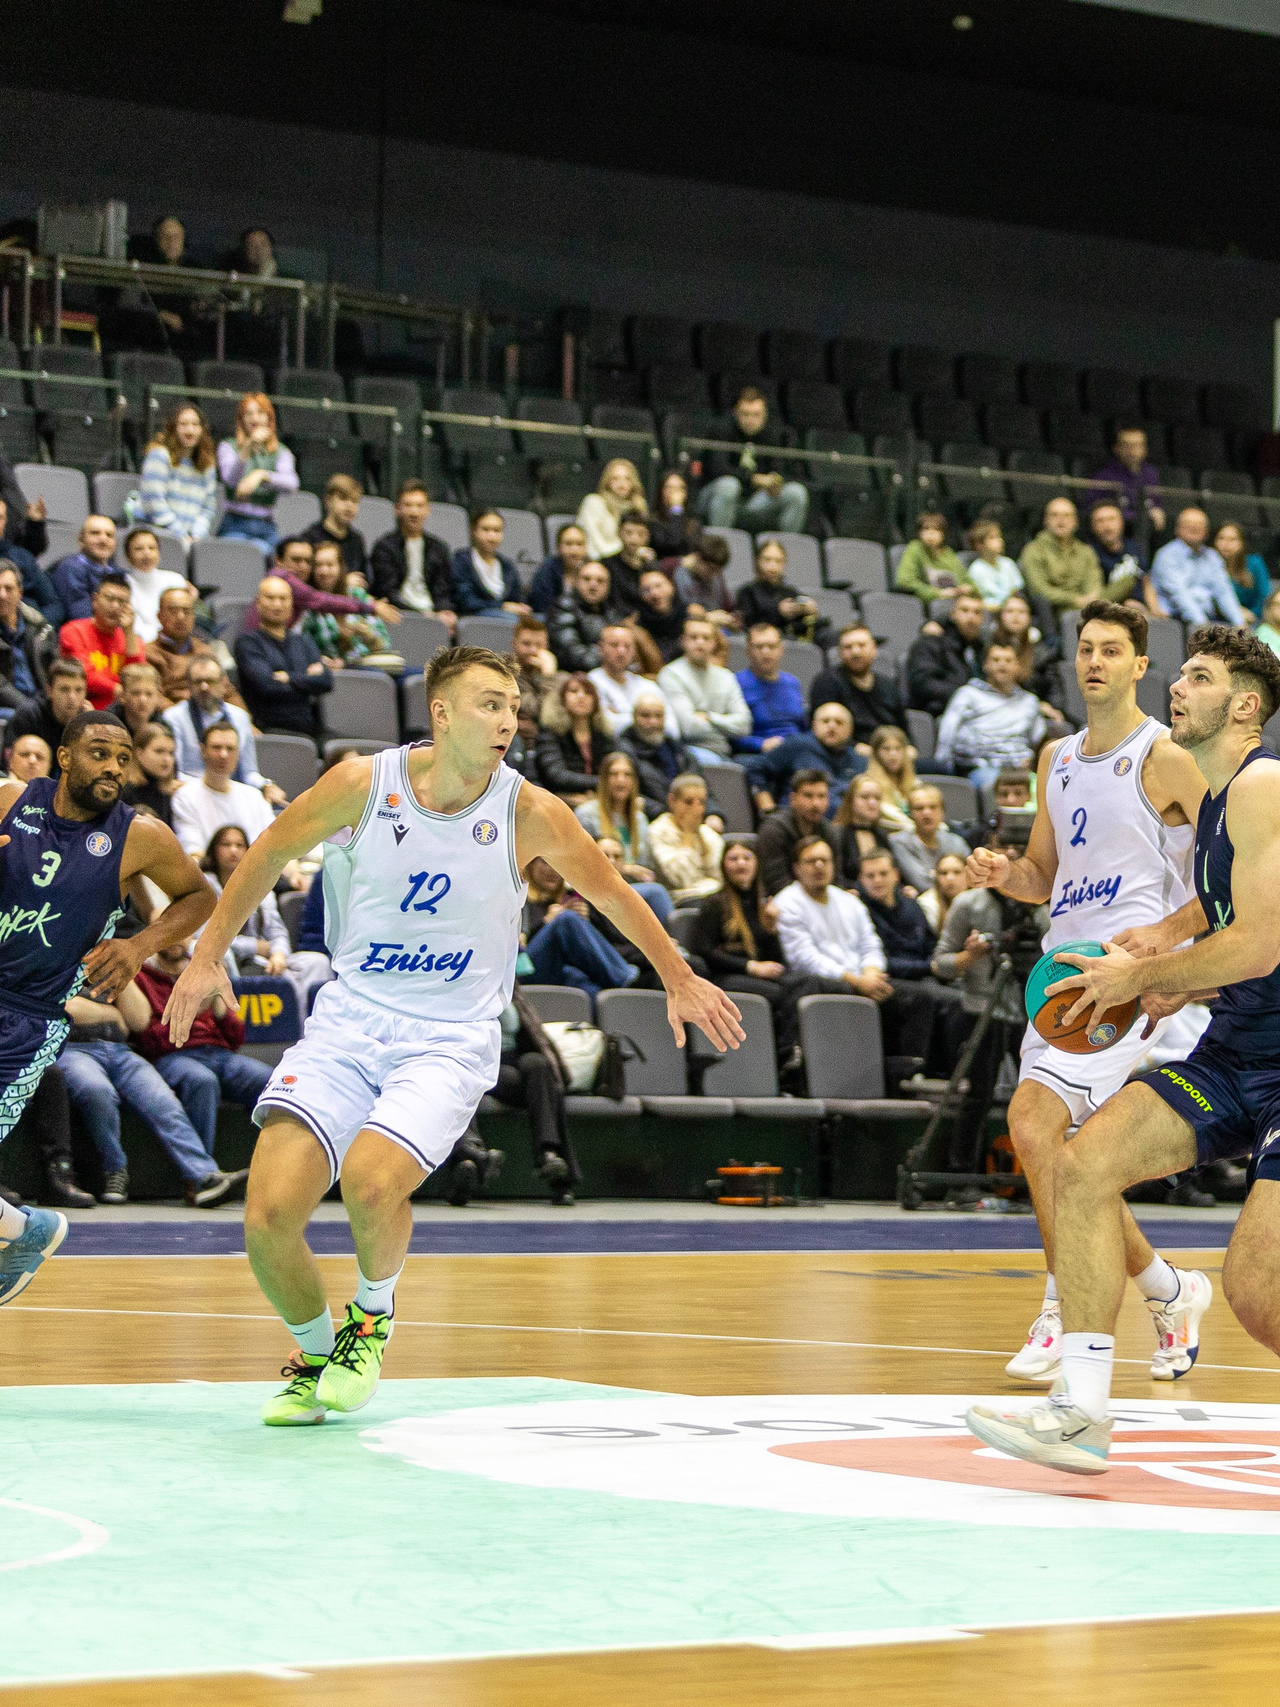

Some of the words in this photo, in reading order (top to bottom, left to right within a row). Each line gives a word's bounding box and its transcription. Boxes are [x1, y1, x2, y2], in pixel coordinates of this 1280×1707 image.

[12, 816, 41, 835] Kempa
[377, 810, 401, 820] ENISEY
[1070, 807, 1087, 847] 2
[32, 851, 62, 888] 3
[400, 871, 451, 915] 12
[1050, 875, 1122, 919] Enisey
[360, 942, 474, 982] Enisey
[236, 993, 284, 1027] VIP
[1160, 1068, 1213, 1112] евроопт
